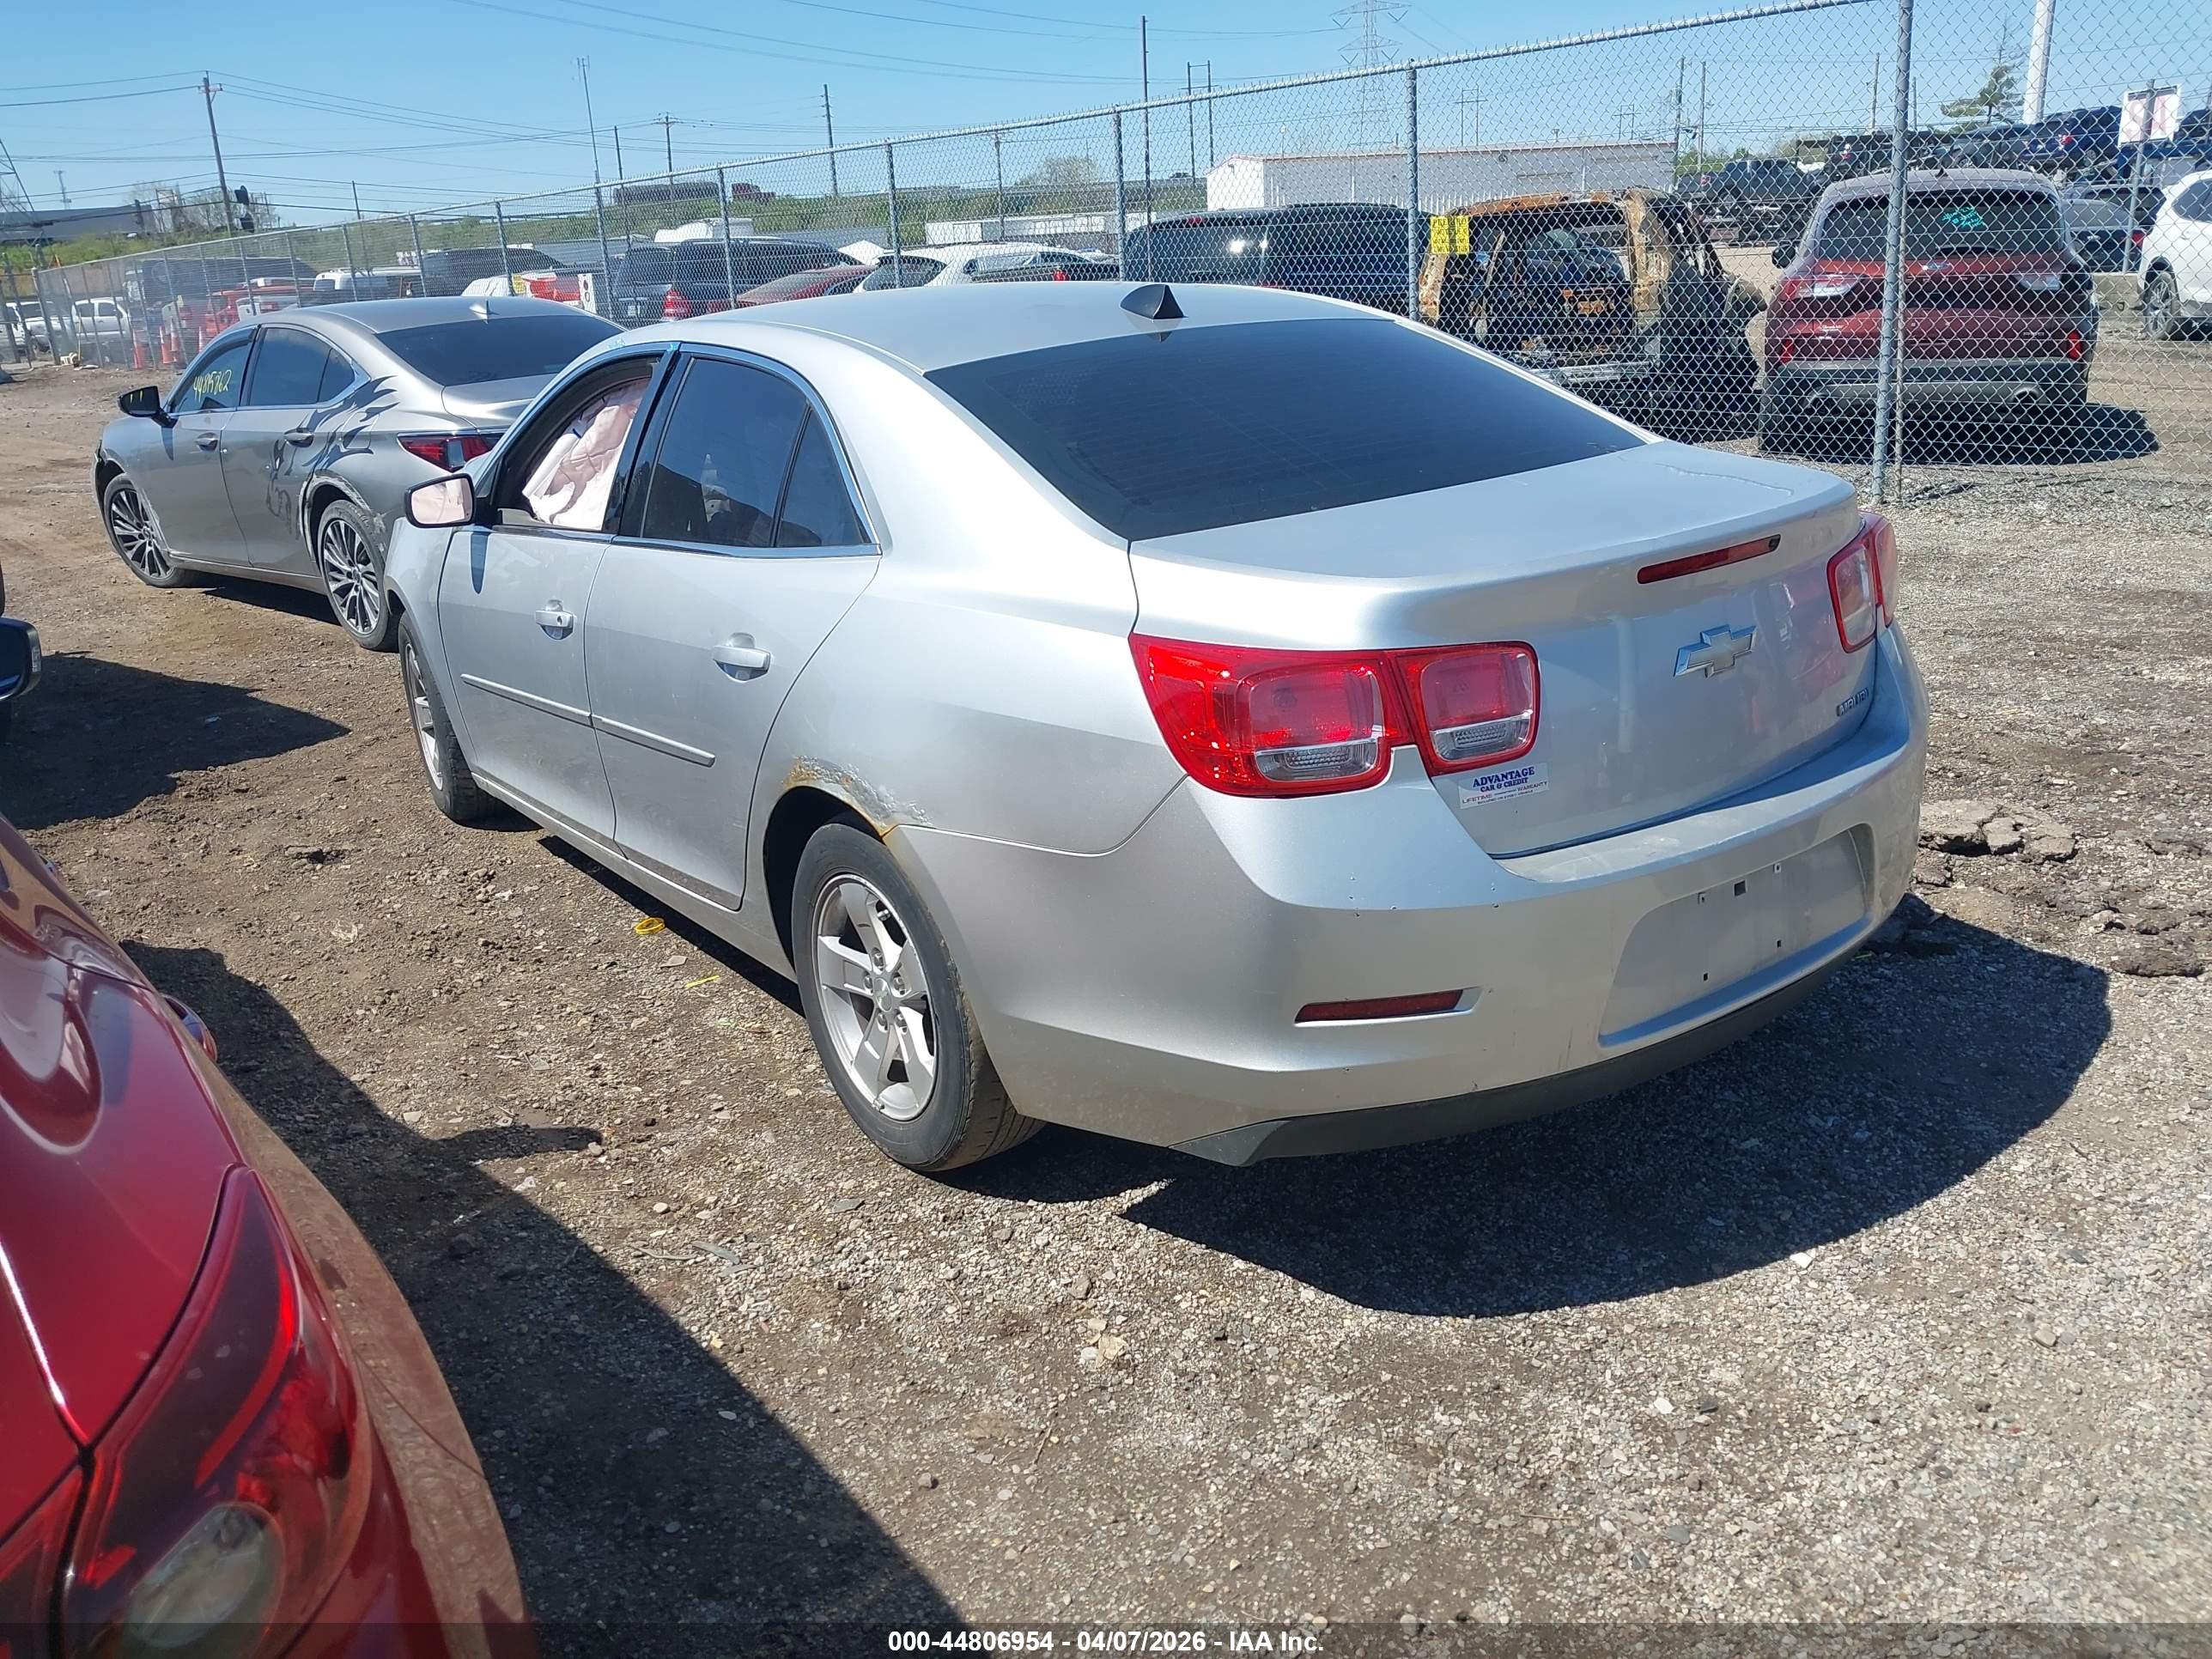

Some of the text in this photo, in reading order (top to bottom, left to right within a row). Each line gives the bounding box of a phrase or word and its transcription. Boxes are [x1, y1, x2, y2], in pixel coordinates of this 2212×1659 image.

[1473, 766, 1535, 787] ADVANTAGE
[1480, 784, 1495, 793] CAR
[1504, 777, 1528, 787] CREDIT
[1462, 781, 1547, 804] LIFETIME WARRANTY
